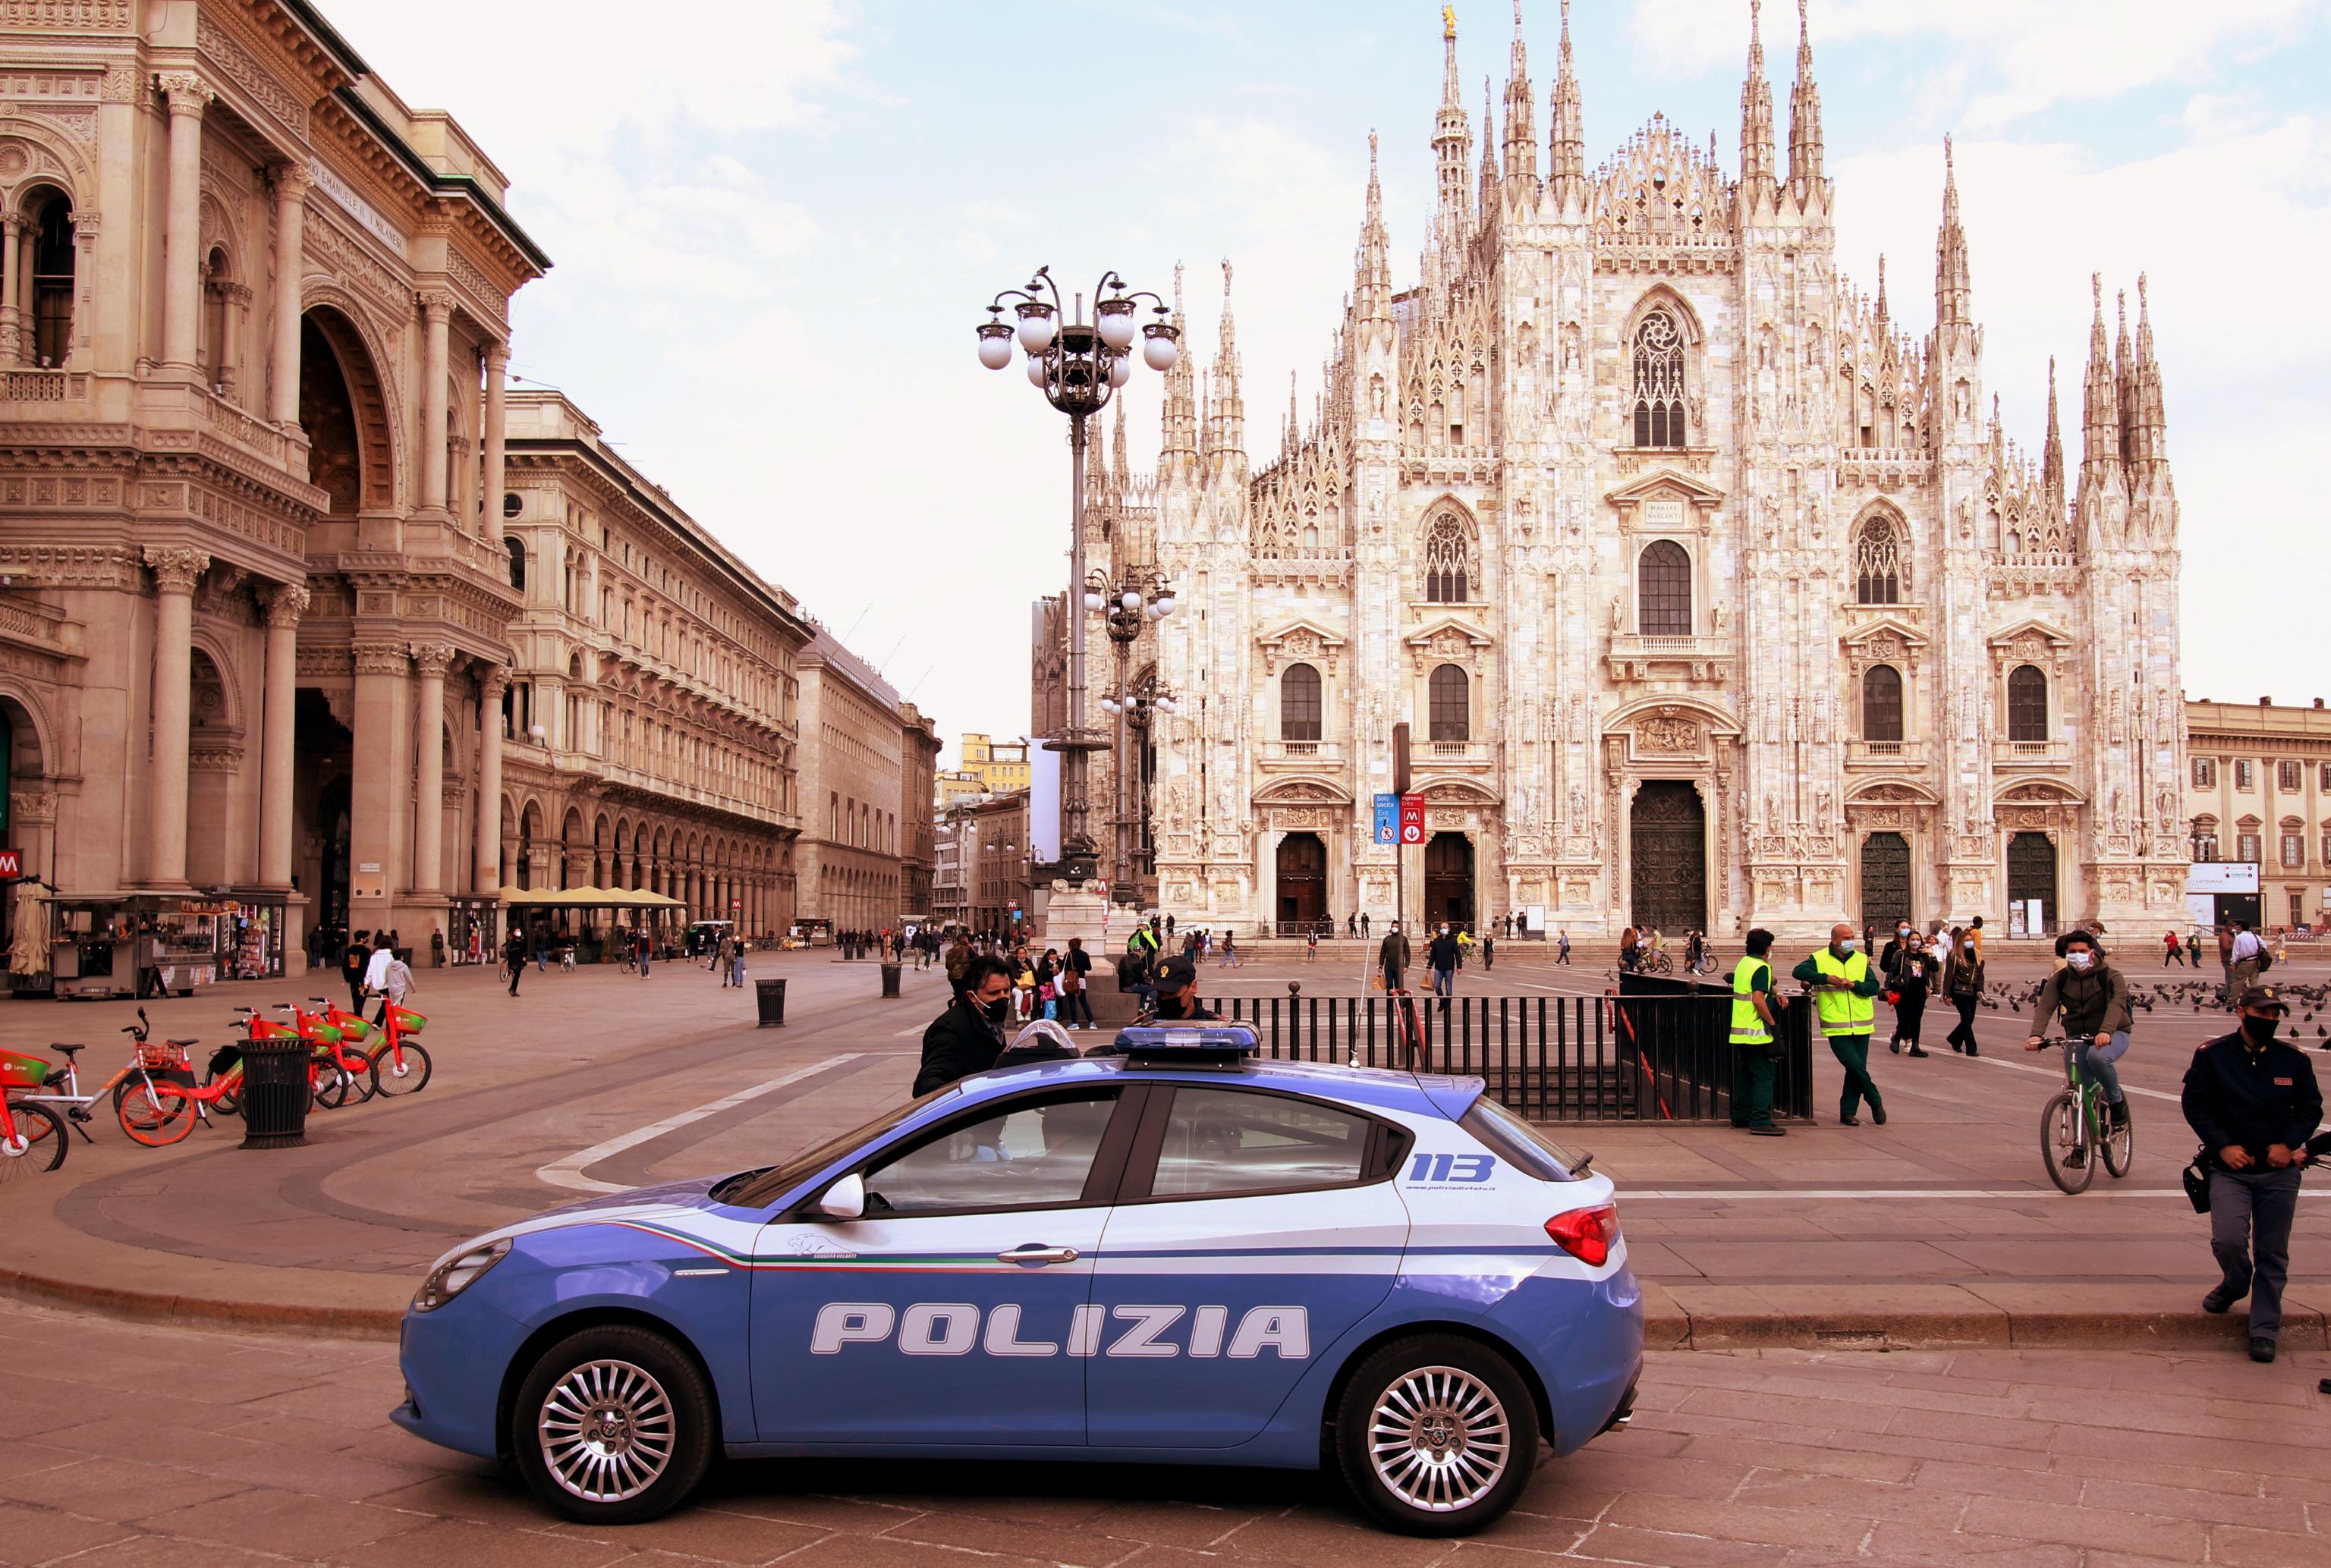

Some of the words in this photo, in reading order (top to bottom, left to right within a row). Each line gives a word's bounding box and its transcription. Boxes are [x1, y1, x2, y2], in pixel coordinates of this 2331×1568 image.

[322, 171, 357, 212] EMANUELE
[376, 218, 401, 250] MILANESI
[1406, 812, 1418, 820] M
[0, 856, 18, 872] M
[1409, 1154, 1496, 1183] 113
[810, 1302, 1310, 1359] POLIZIA
